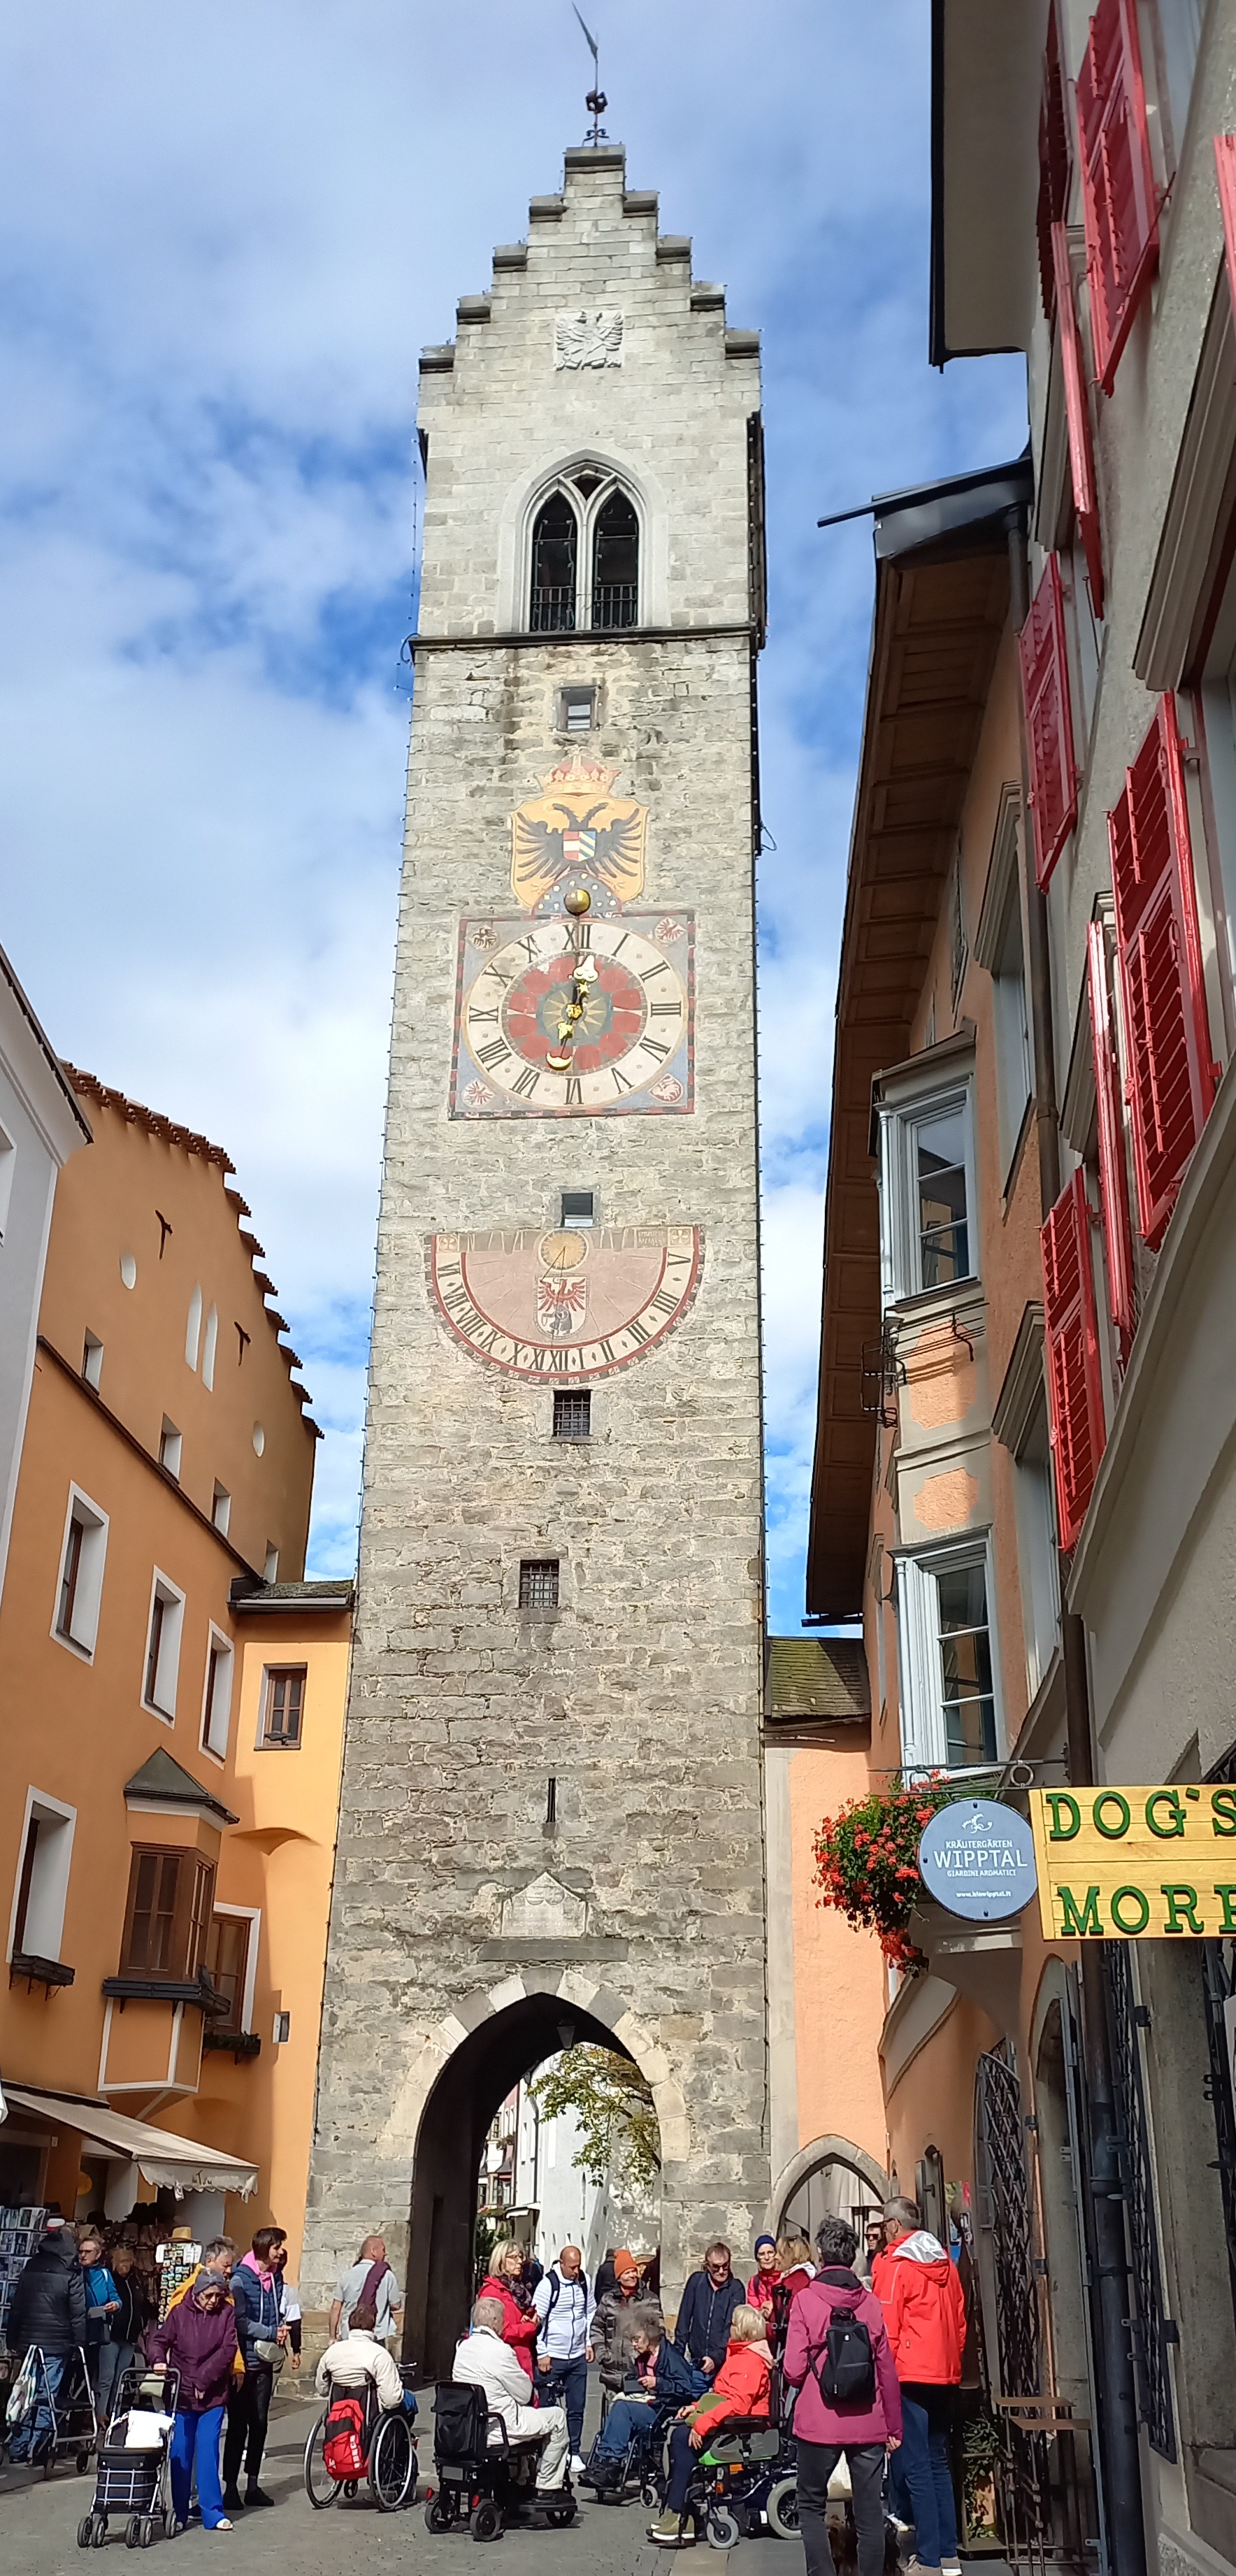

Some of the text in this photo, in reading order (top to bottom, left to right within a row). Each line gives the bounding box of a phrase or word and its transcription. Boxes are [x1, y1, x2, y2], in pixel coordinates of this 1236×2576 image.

[561, 924, 593, 950] XII
[610, 933, 631, 957] I
[482, 962, 516, 989] X
[638, 960, 670, 983] II
[650, 1001, 682, 1017] III
[475, 1036, 512, 1073] VIII
[508, 1066, 540, 1099] VII
[563, 1078, 584, 1105] VI
[611, 1068, 635, 1094] V
[505, 1341, 527, 1366] X
[577, 1347, 586, 1370] I
[598, 1338, 617, 1364] II
[625, 1319, 654, 1346] III
[667, 1252, 691, 1268] V
[945, 1839, 1013, 1849] KRÄUTERGÄRTEN
[933, 1849, 1028, 1868] WIPPTAL
[979, 1869, 1016, 1877] AROMATICI
